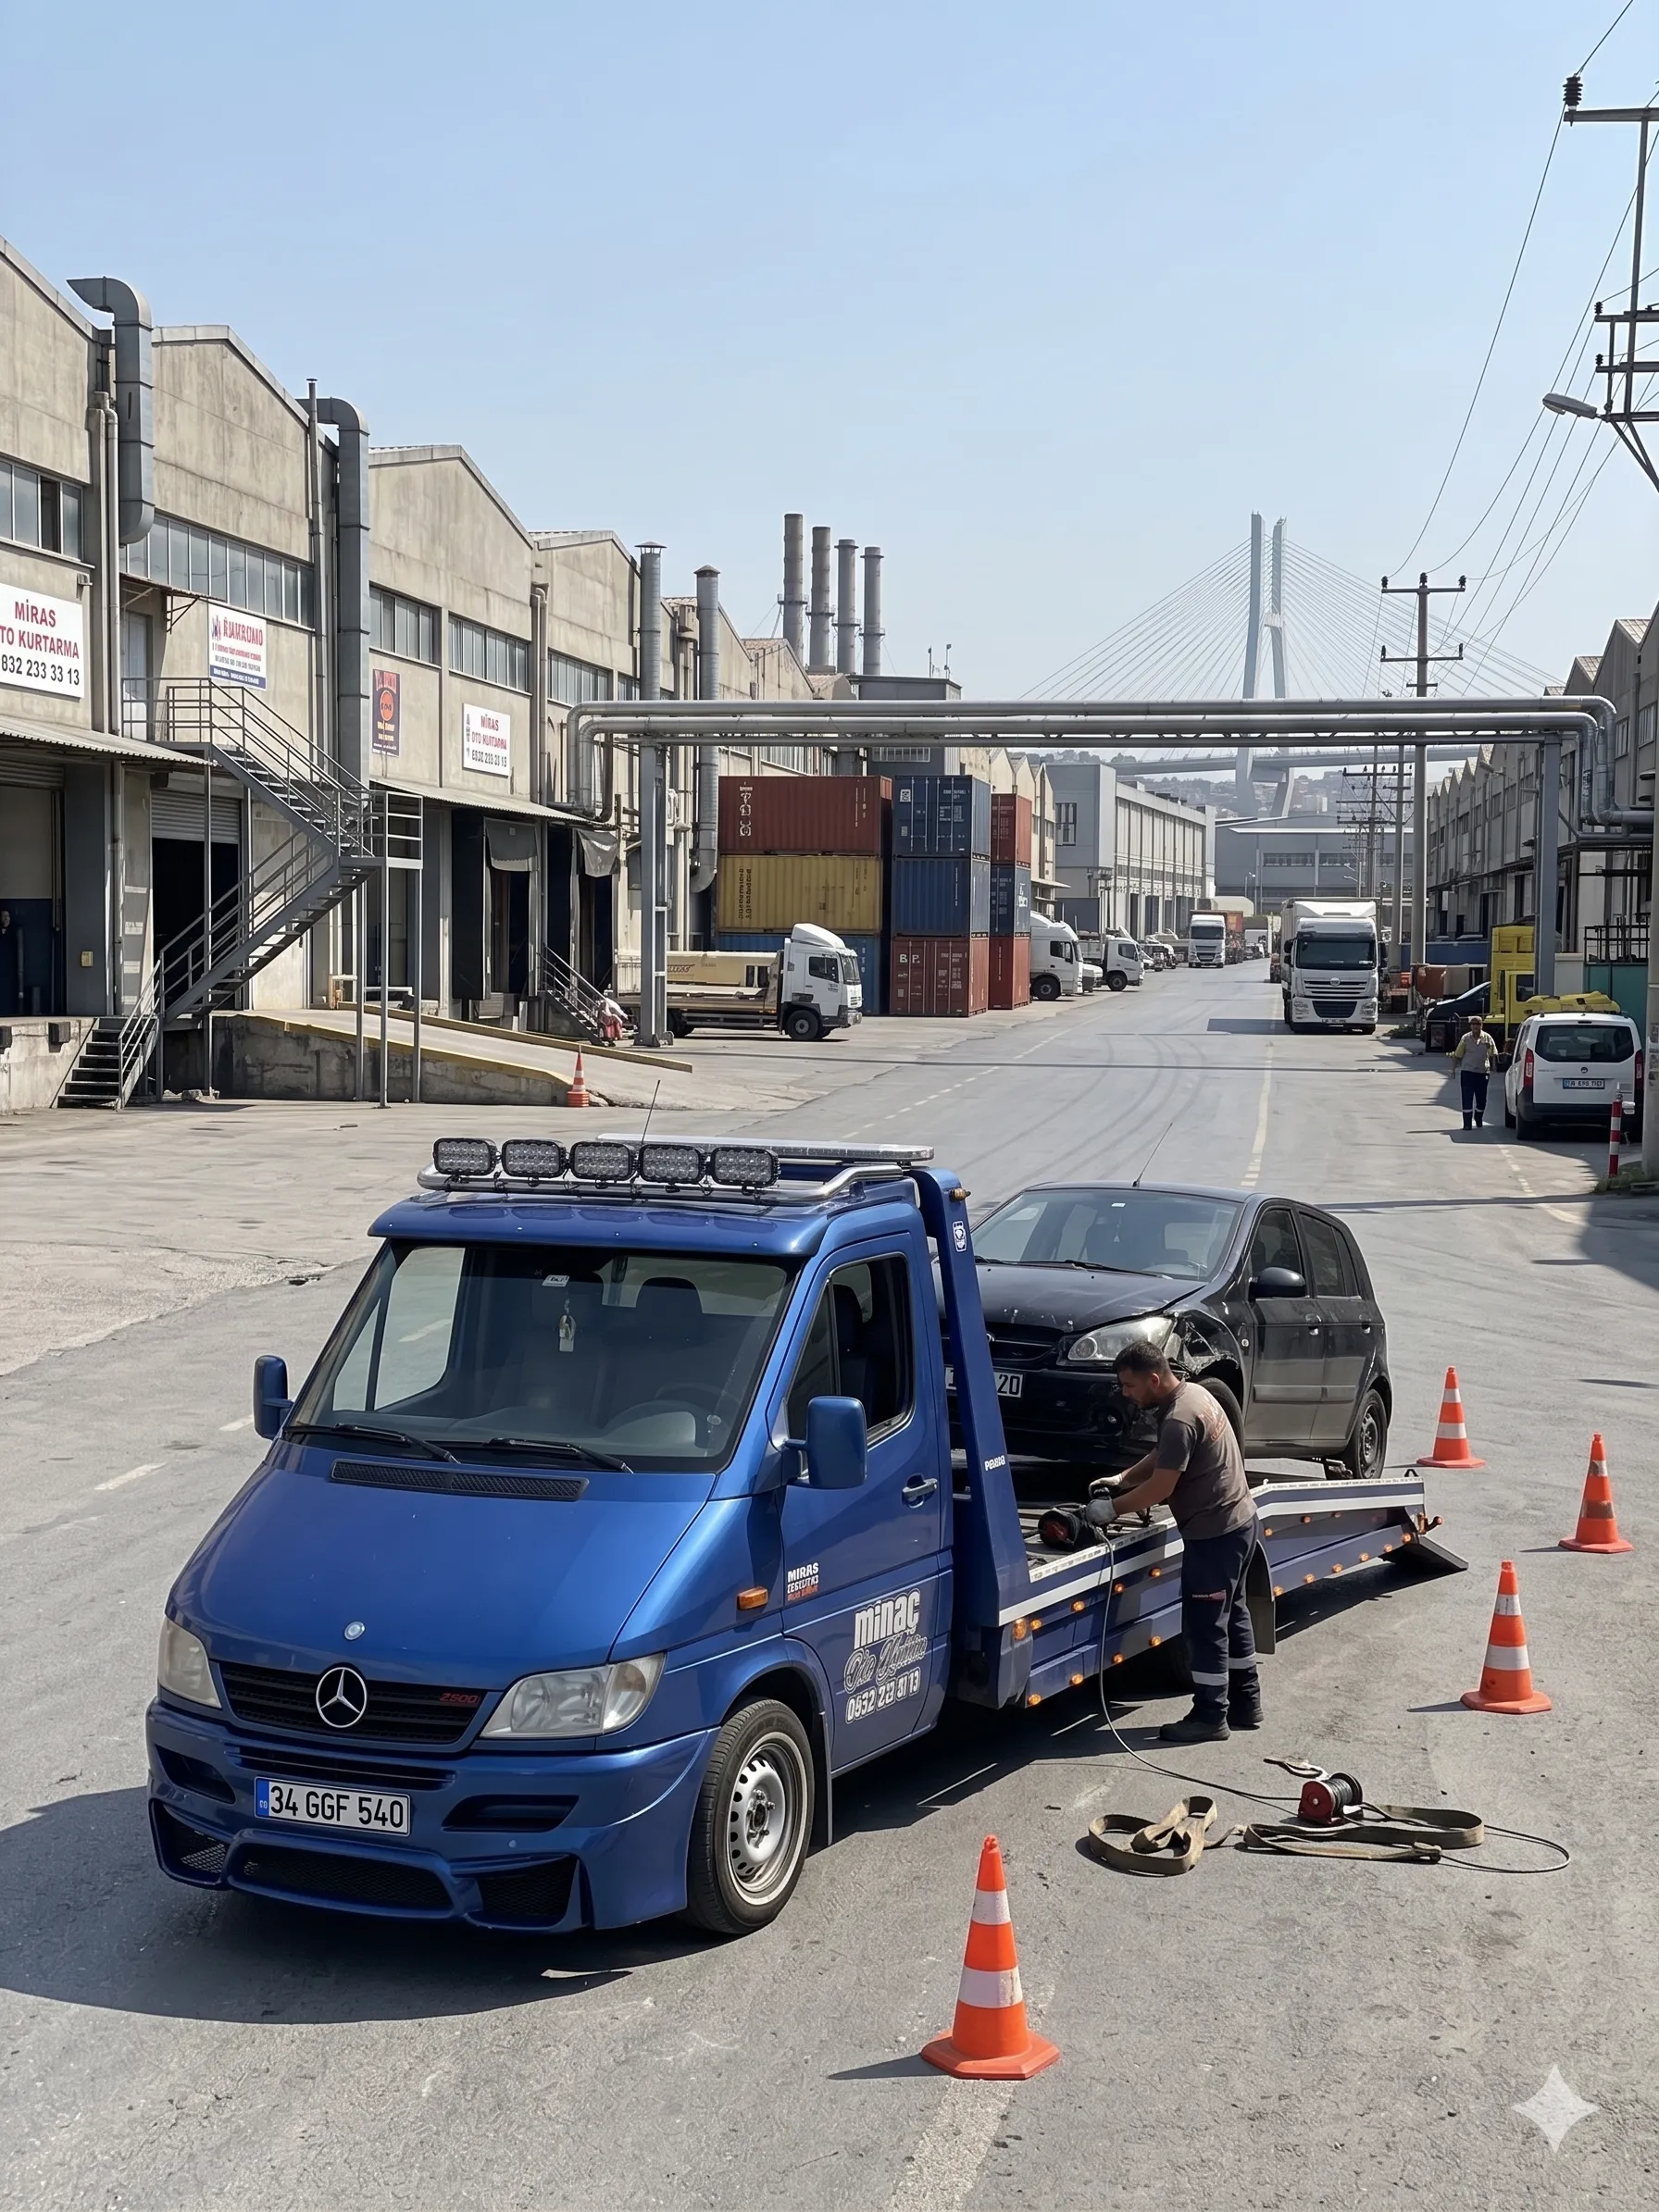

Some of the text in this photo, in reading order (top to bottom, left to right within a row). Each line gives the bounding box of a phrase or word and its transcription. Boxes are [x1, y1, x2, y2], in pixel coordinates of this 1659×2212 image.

[15, 599, 56, 628] MİRAS
[19, 629, 80, 660] KURTARMA
[26, 659, 47, 679] 233
[50, 664, 64, 682] 33
[67, 667, 81, 686] 13
[787, 1561, 819, 1584] MIRAS
[270, 1785, 404, 1829] 34 GGF 540
